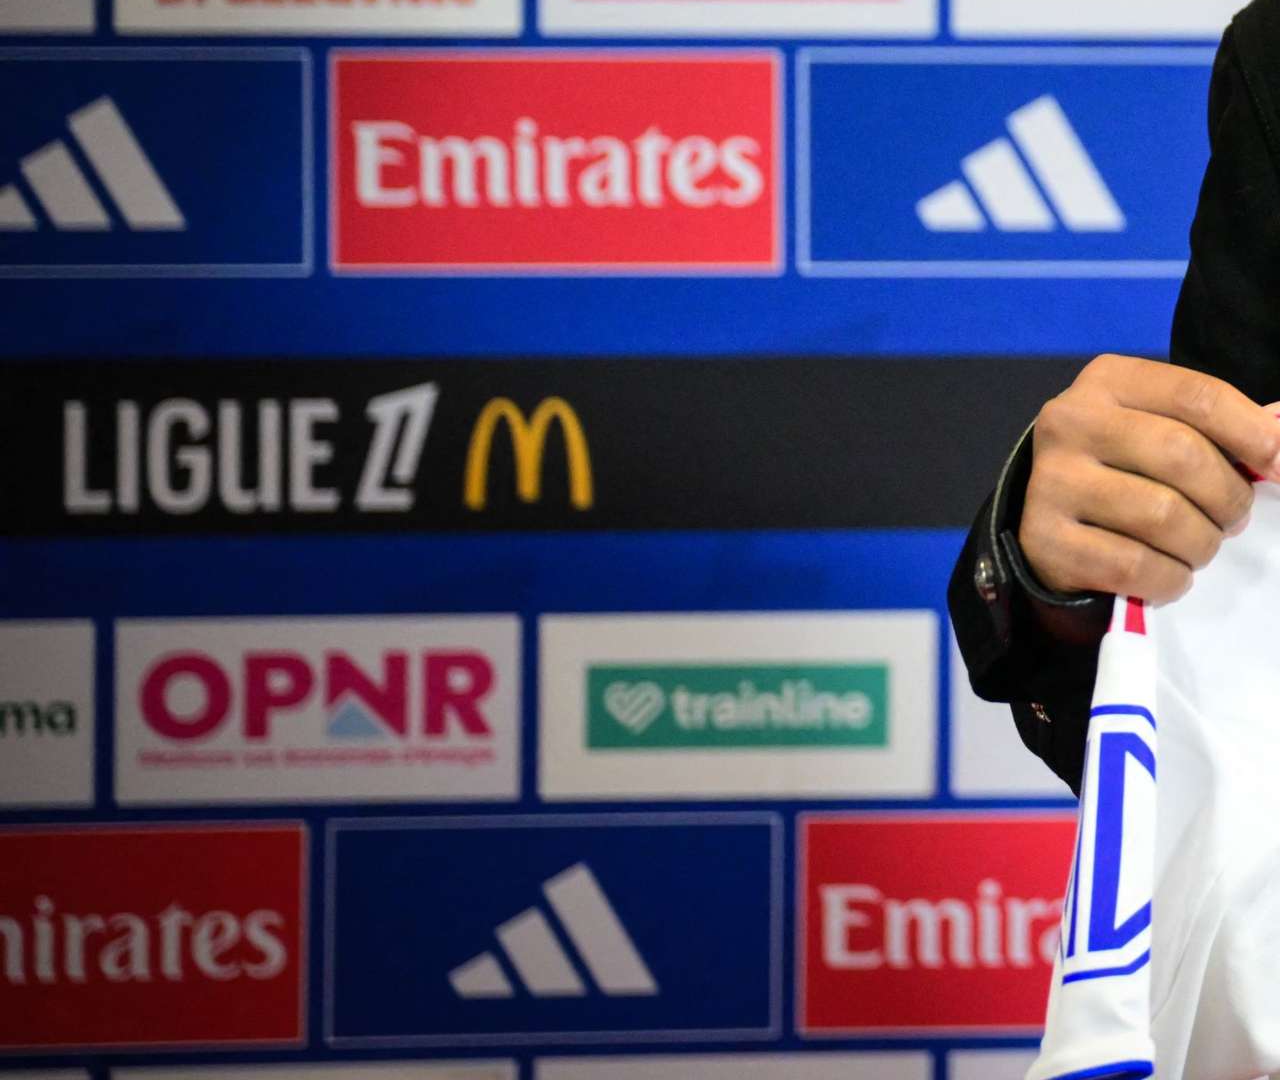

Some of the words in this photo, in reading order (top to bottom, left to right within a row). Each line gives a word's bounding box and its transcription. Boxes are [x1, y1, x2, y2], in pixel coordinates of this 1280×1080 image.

[352, 115, 765, 208] Emirates
[64, 397, 341, 512] LIGUE
[138, 649, 495, 741] OPNR
[671, 679, 874, 731] trainline
[0, 894, 288, 984] irates
[820, 877, 1066, 969] Emir
